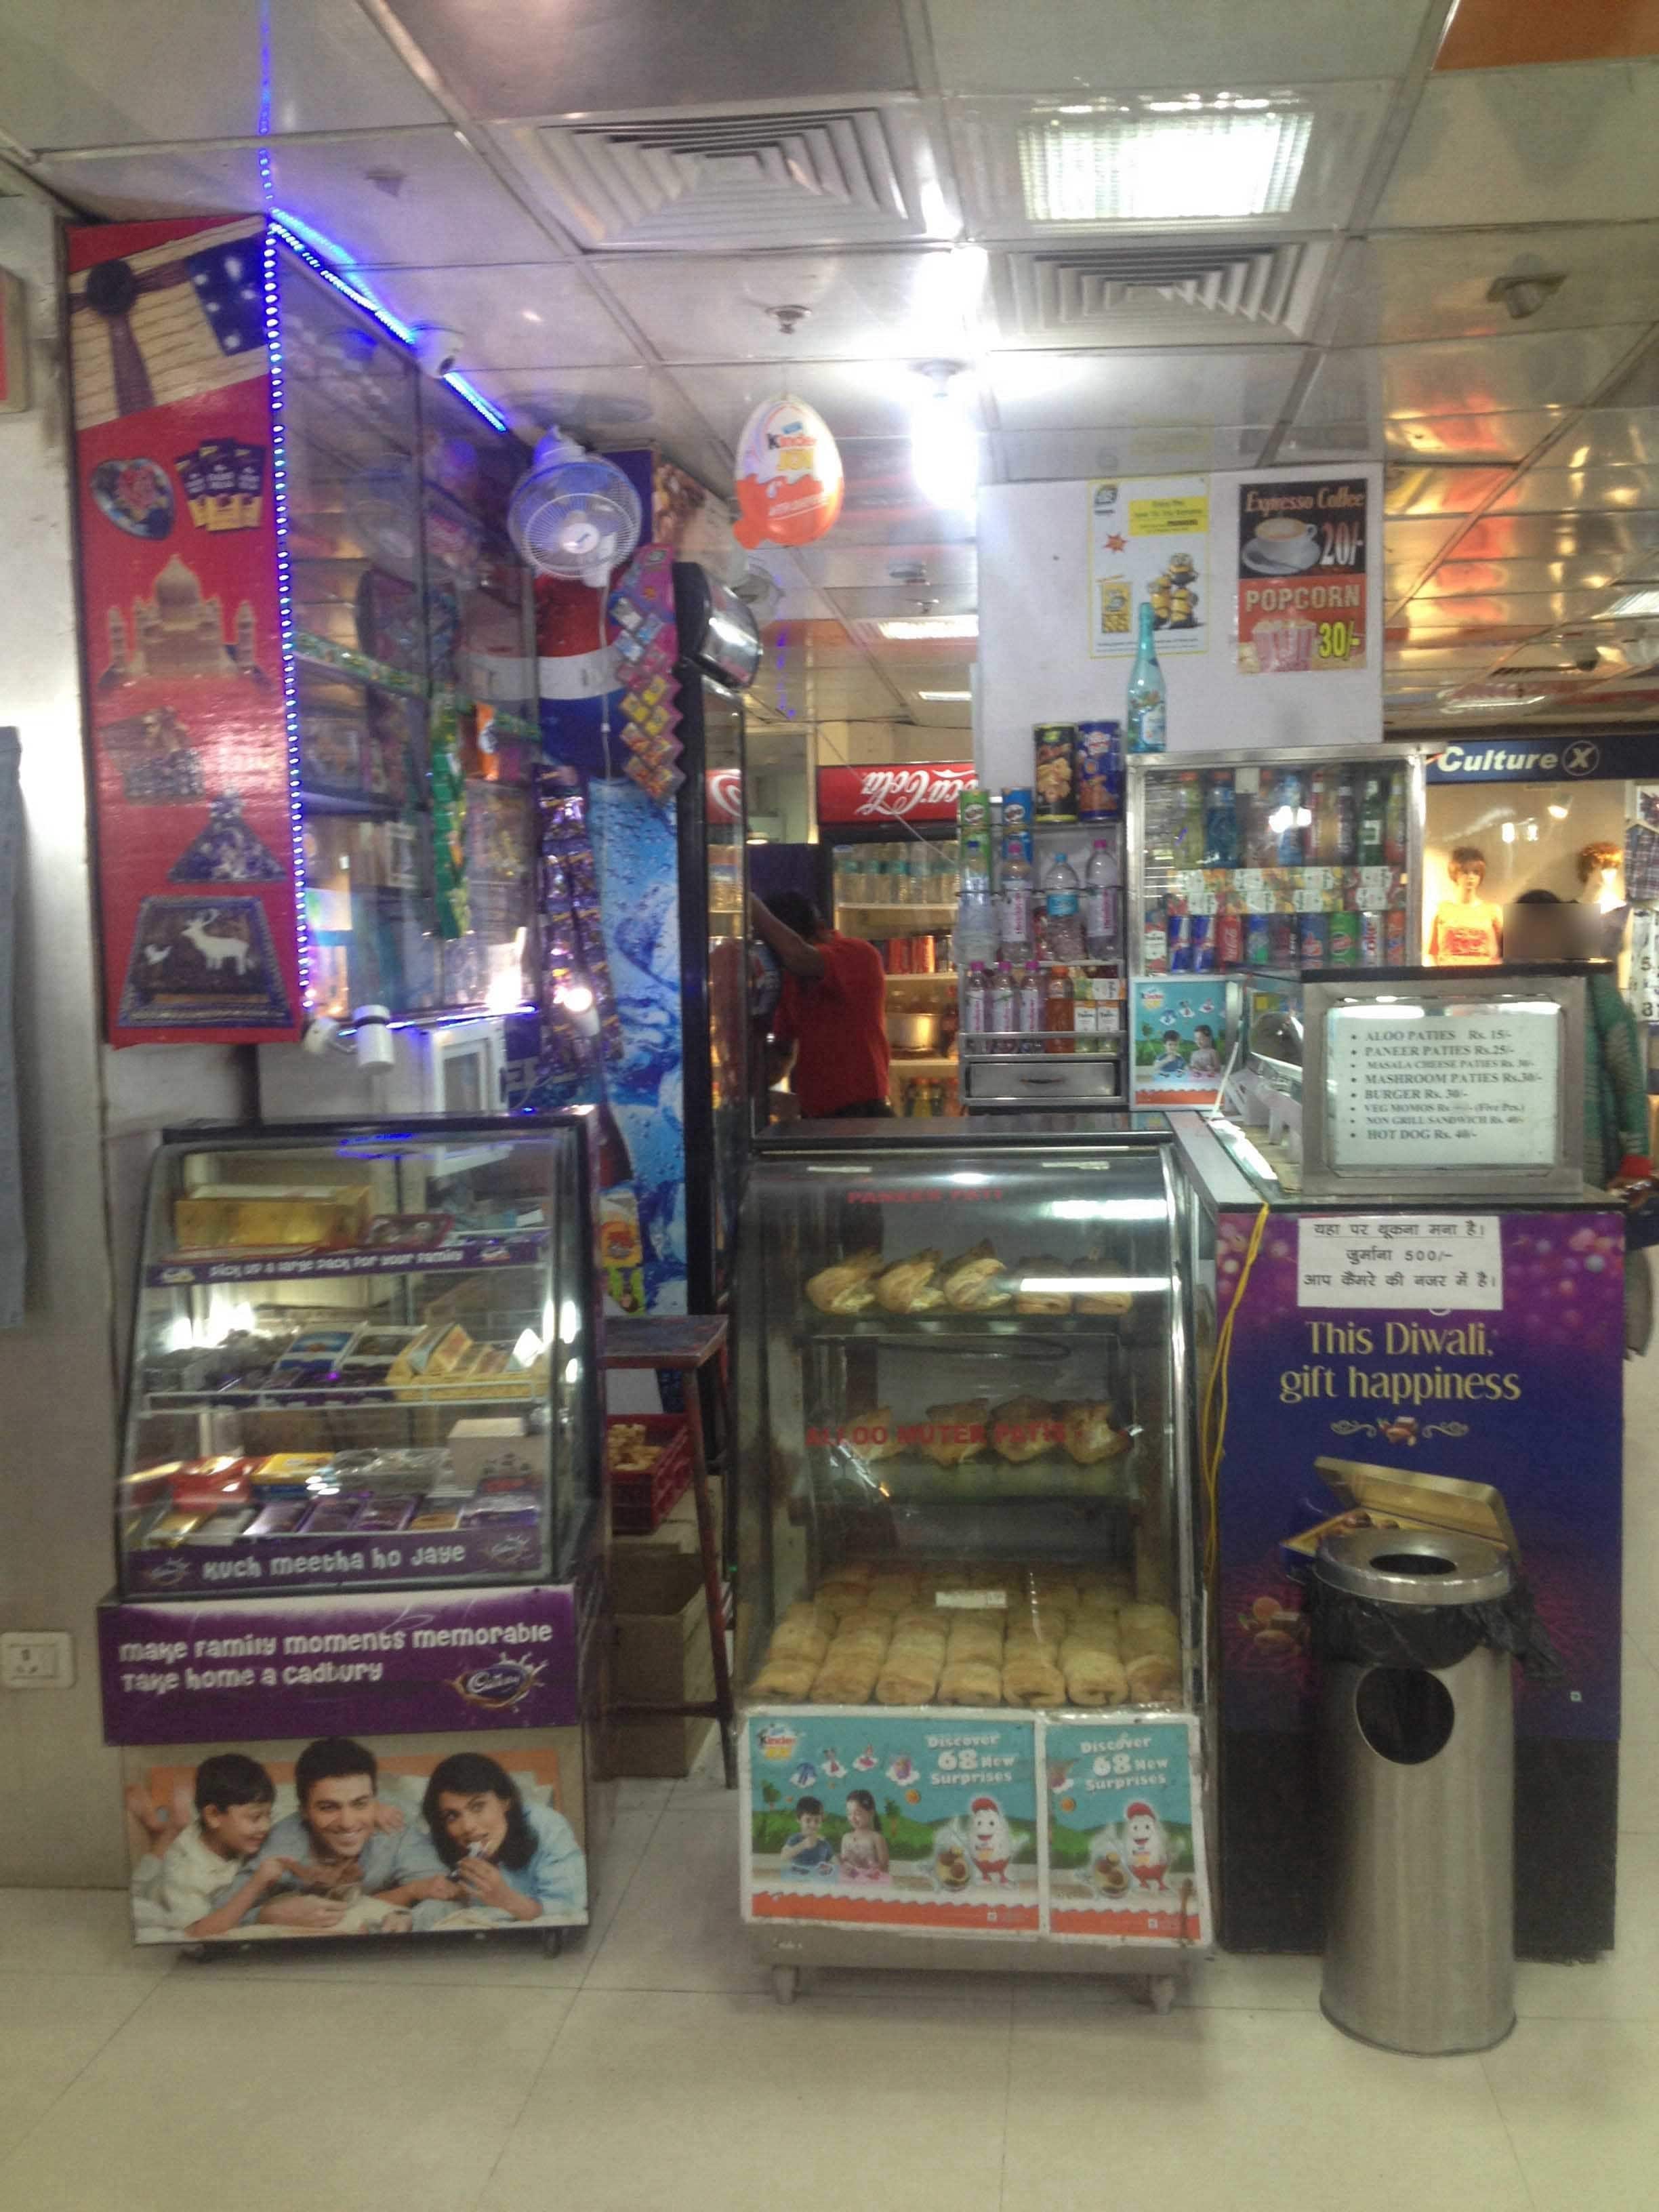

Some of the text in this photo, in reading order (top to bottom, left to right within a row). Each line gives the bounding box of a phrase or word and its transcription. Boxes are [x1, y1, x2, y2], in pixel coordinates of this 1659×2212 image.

[1245, 584, 1361, 612] POPCORN
[1319, 621, 1359, 658] 30/-
[1439, 745, 1558, 772] Culture
[1366, 1031, 1404, 1041] ALOO
[1365, 1046, 1419, 1056] PANEER
[1365, 1089, 1421, 1099] BURGER
[1368, 1129, 1397, 1139] HOT
[1399, 1129, 1431, 1139] DOG
[1303, 1274, 1332, 1286] आप
[1385, 1271, 1405, 1286] की
[1306, 1322, 1374, 1355] This
[1279, 1365, 1523, 1406] gift happiness
[373, 1546, 402, 1570] ho
[283, 1631, 406, 1655] moments
[411, 1622, 553, 1649] memorable
[184, 1667, 255, 1691] home
[260, 1667, 277, 1687] a
[925, 1733, 1000, 1748] Discover
[1080, 1737, 1151, 1754] Discover
[938, 1749, 978, 1771] 68
[1092, 1753, 1132, 1776] 68
[932, 1771, 1012, 1785] Surprises
[1084, 1773, 1166, 1793] Surprises
